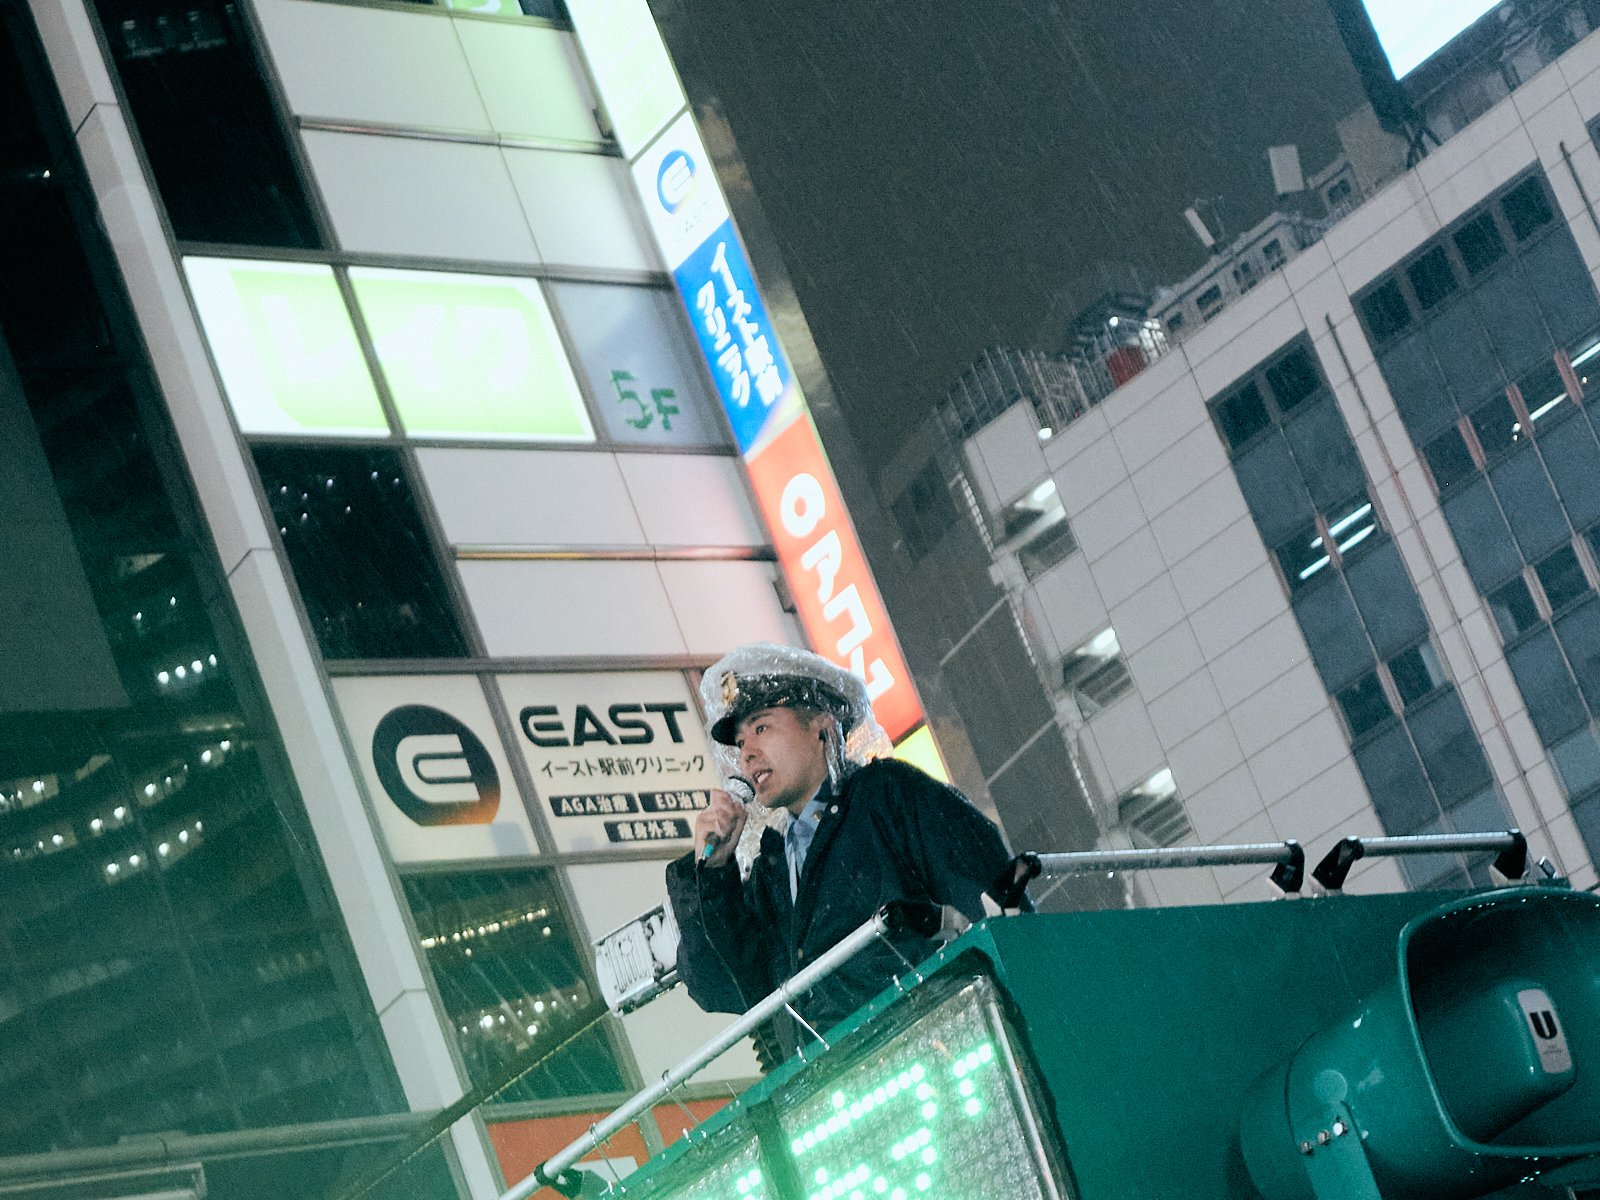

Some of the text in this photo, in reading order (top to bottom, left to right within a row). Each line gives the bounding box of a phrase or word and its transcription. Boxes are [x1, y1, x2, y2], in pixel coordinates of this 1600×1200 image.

[260, 294, 529, 392] レイク
[697, 280, 750, 407] クリニック
[610, 369, 680, 431] 5F
[519, 701, 688, 747] EAST
[541, 755, 705, 778] イースト駅前クリニック
[561, 793, 630, 815] AGA治療
[1529, 1010, 1558, 1040] U
